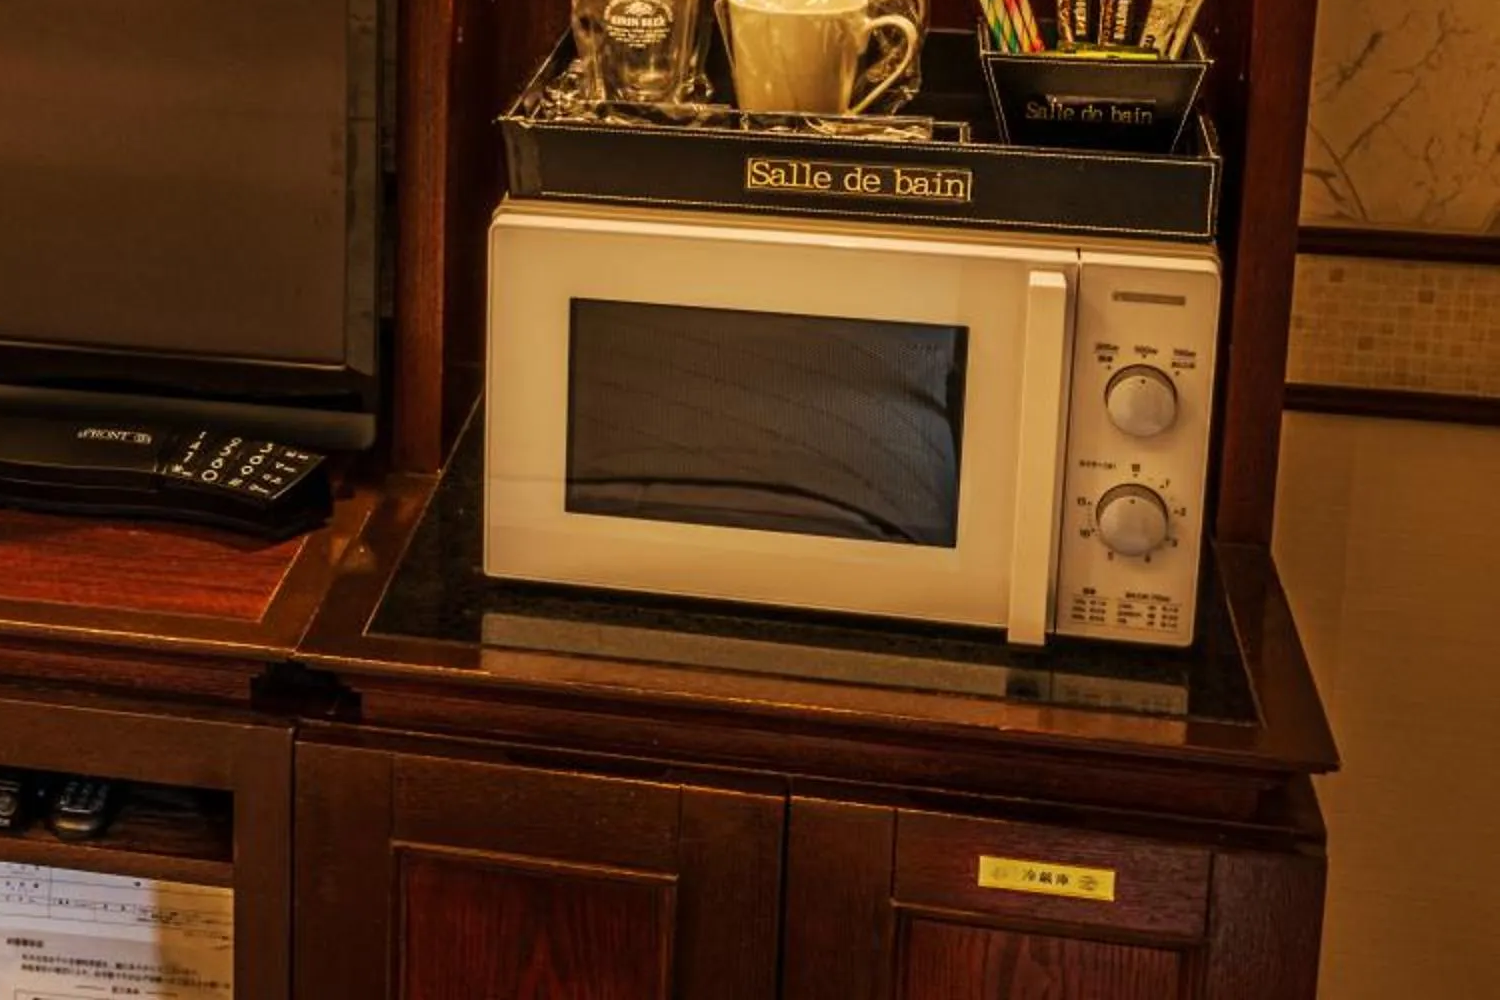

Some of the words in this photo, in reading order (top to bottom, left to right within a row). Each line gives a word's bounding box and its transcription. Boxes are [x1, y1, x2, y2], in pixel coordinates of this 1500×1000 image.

[1025, 100, 1076, 121] Salle
[1111, 104, 1153, 124] bain
[751, 161, 832, 189] Salle
[843, 168, 881, 192] de
[894, 168, 965, 197] bain
